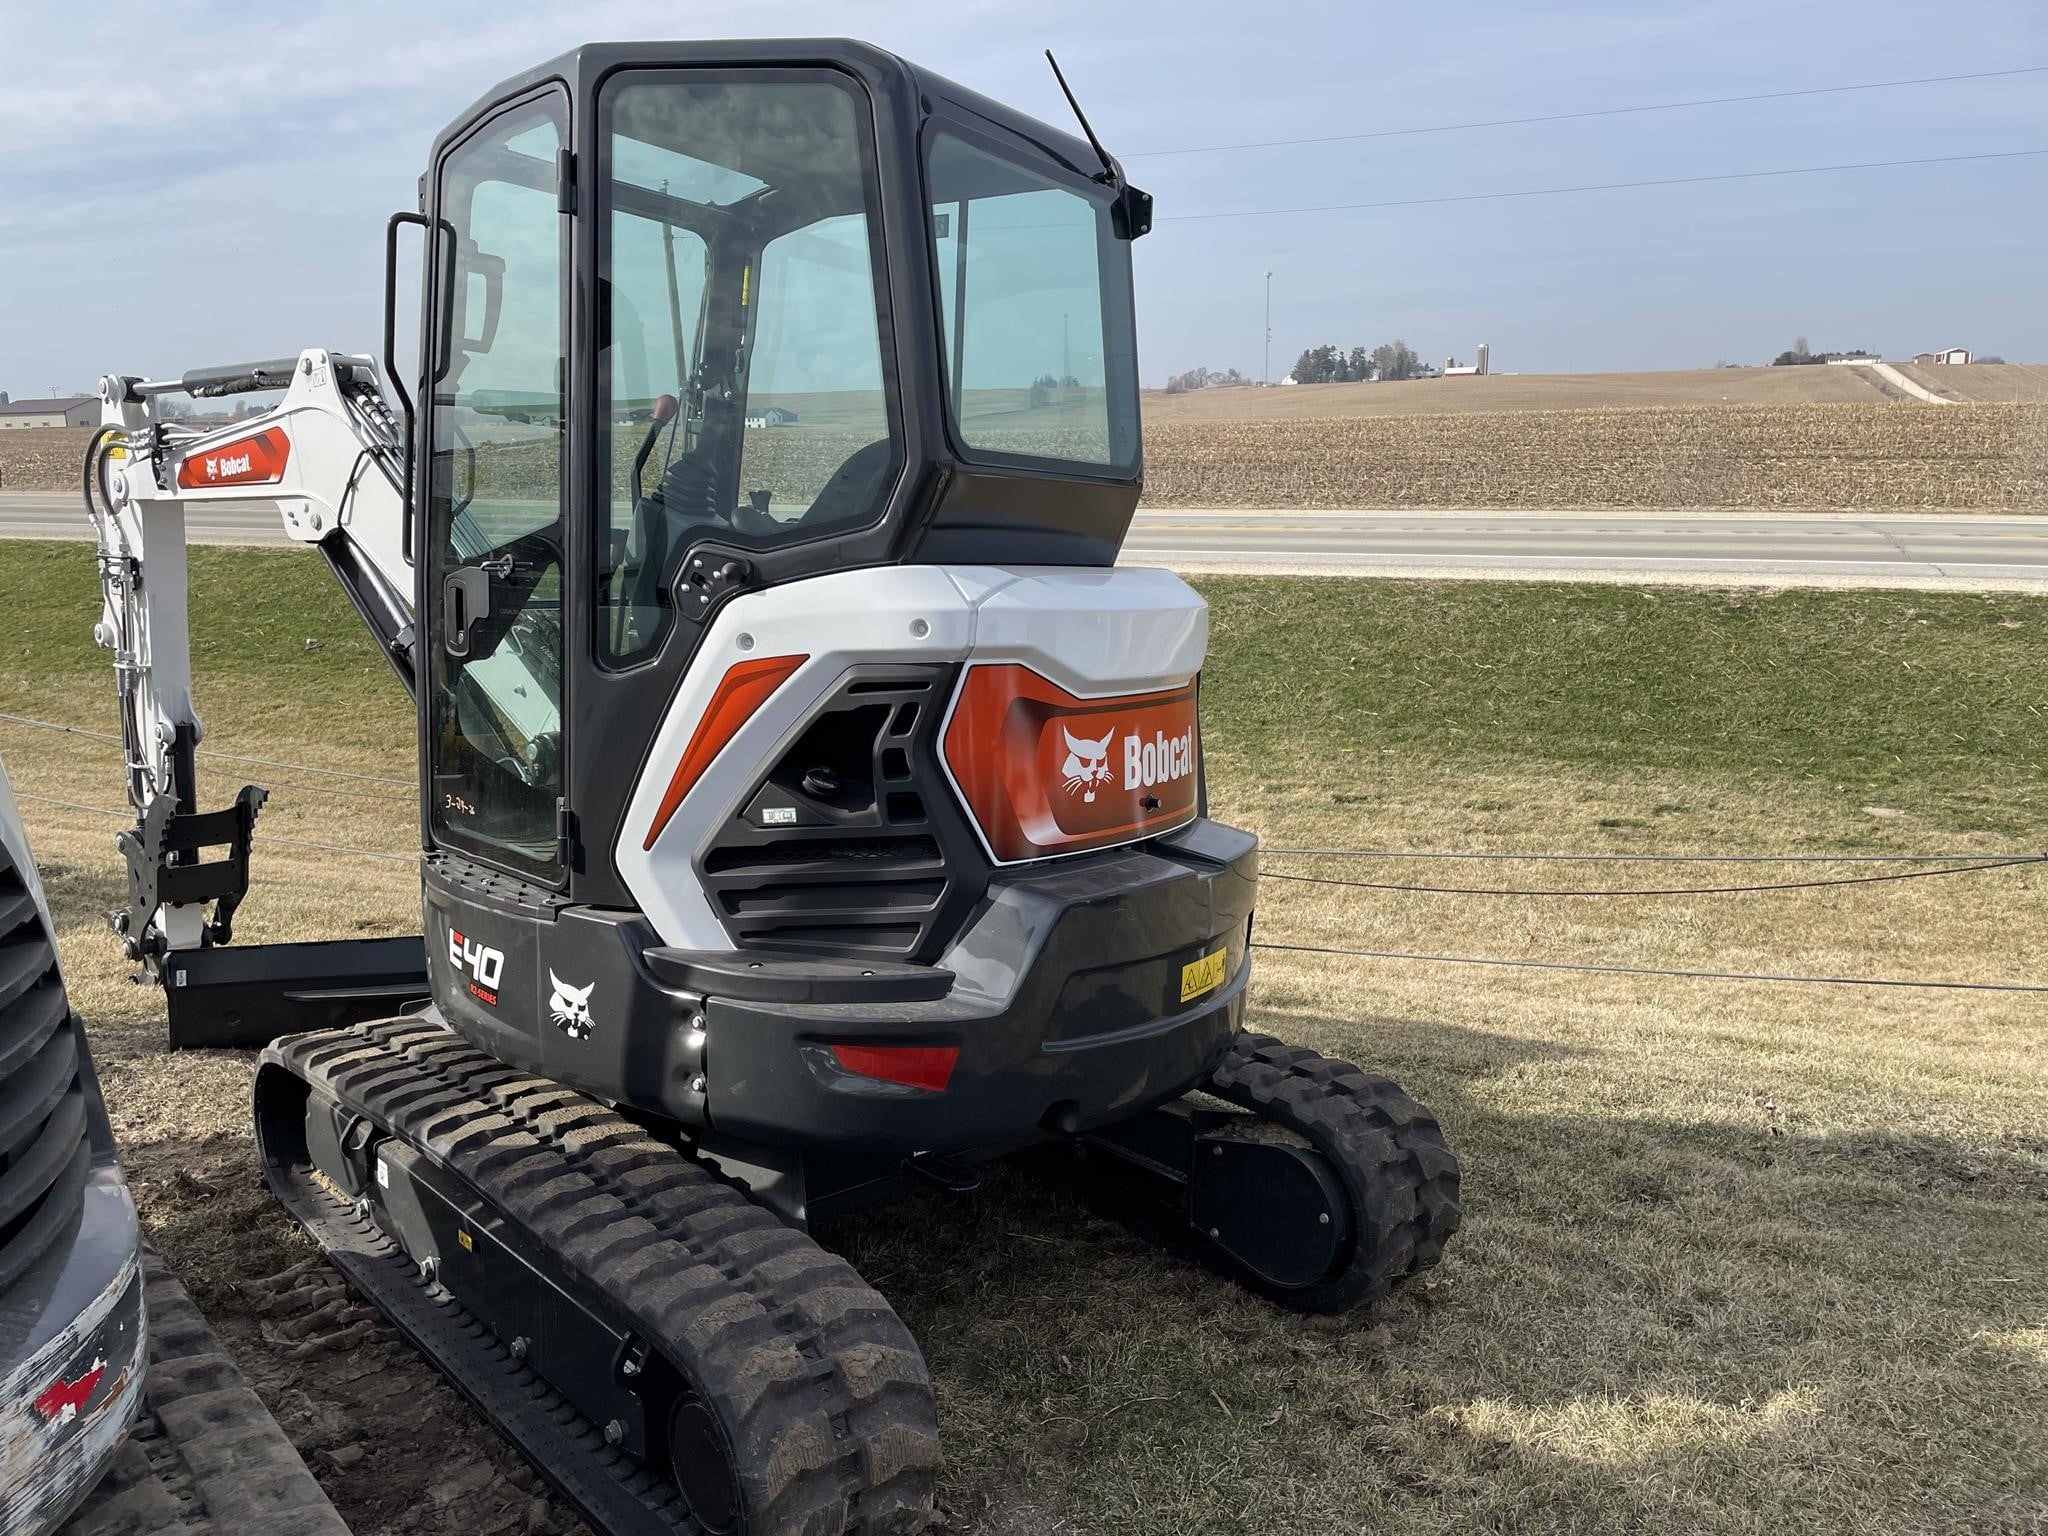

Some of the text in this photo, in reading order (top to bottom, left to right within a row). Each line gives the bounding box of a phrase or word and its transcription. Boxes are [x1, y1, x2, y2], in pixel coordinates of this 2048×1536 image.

[220, 454, 251, 477] Bobcat
[1124, 725, 1193, 791] Bobcat
[449, 927, 505, 991] E40
